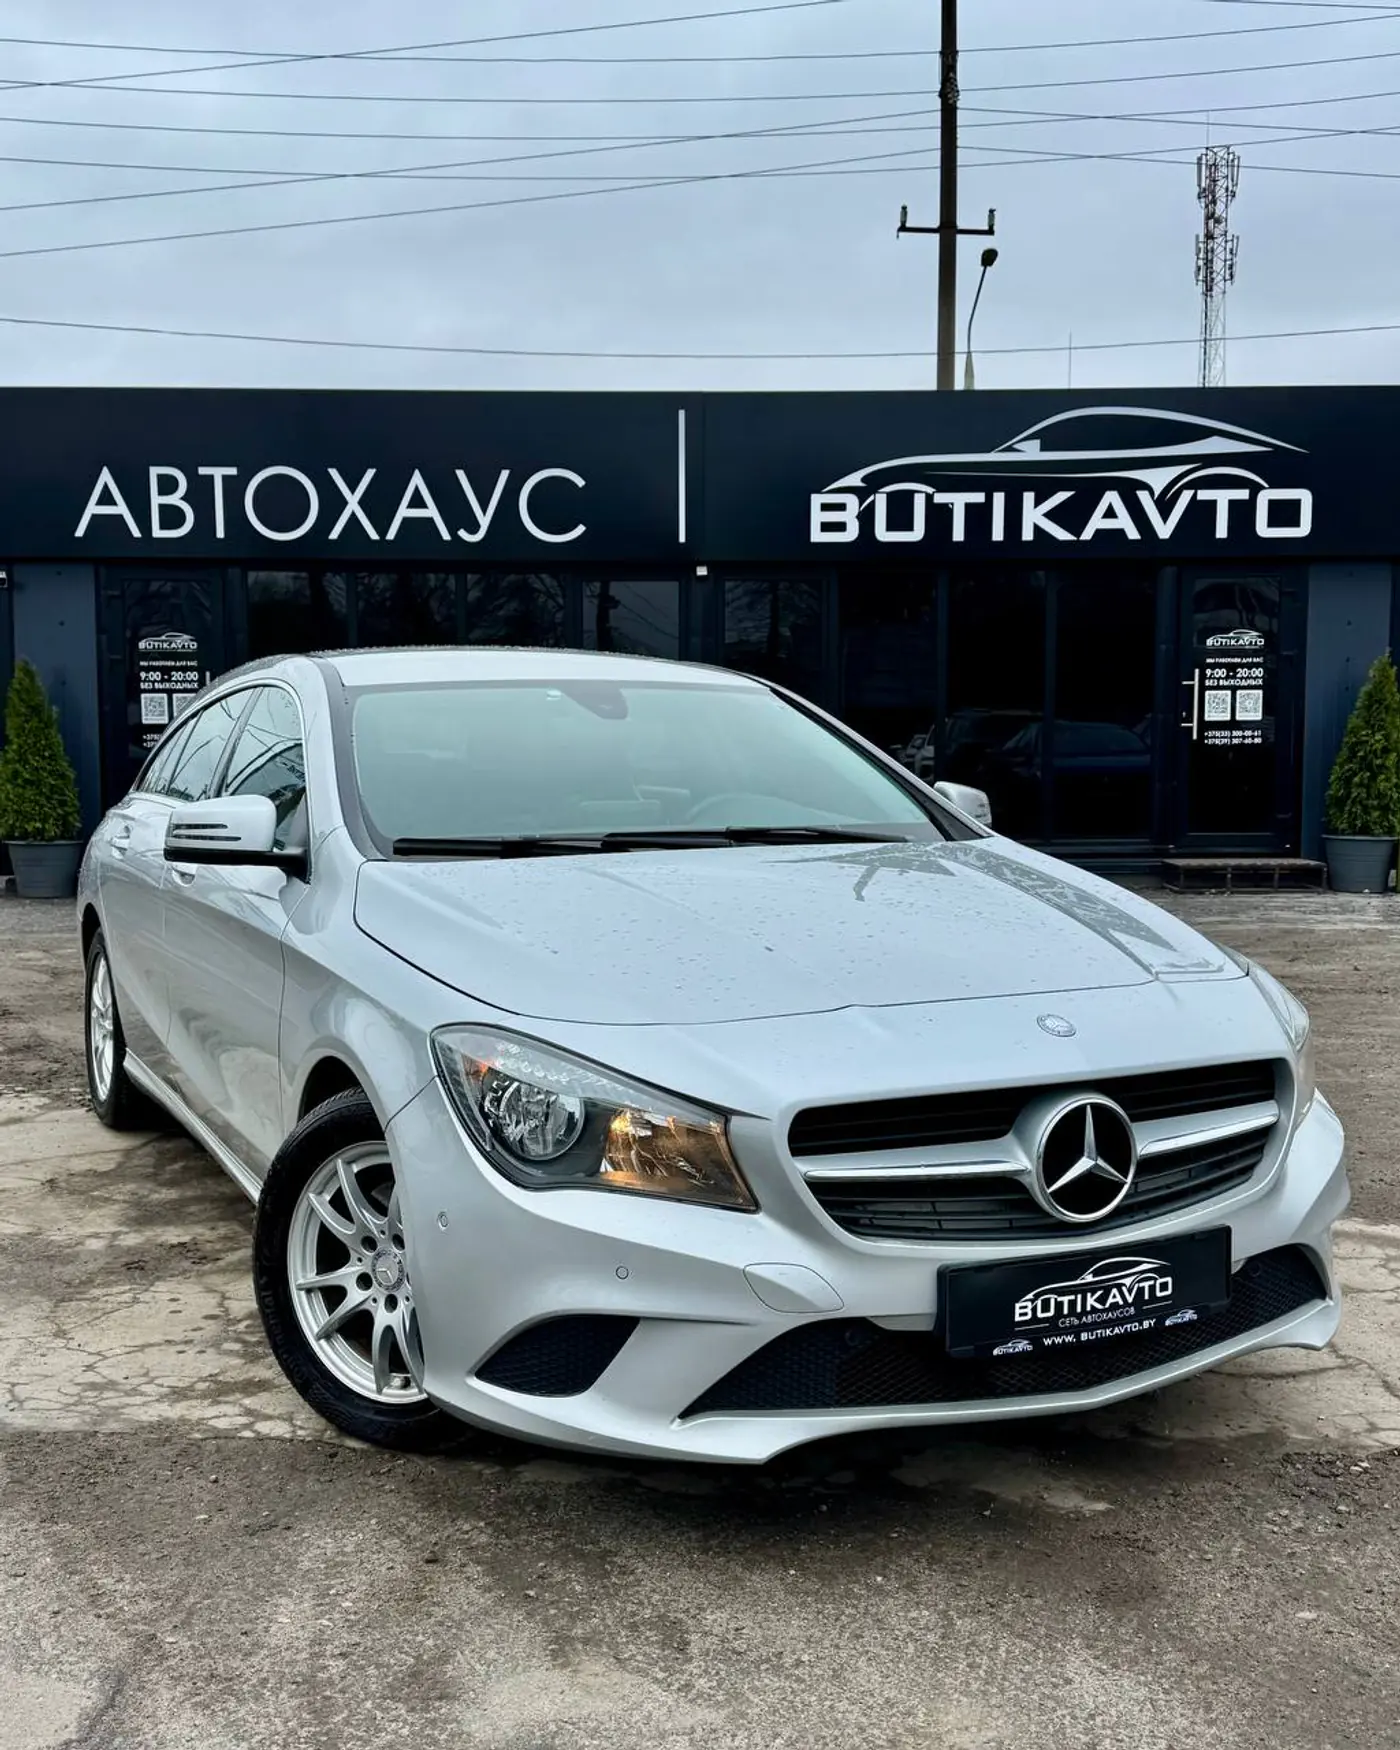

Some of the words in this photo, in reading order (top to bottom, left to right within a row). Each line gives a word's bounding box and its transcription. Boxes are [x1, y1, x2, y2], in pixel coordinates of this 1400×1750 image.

[74, 465, 587, 543] АВТОХАУС
[810, 488, 1313, 543] BUTIKAVTO
[138, 641, 198, 649] BUTIKAVTO
[139, 671, 162, 681] 9:00
[170, 671, 199, 681] 20:00
[1205, 668, 1227, 678] 9:00
[1236, 667, 1264, 678] 20:00
[1219, 678, 1263, 686] ВЫХОДНЫХ
[1014, 1276, 1173, 1322] BUTIKAVTO
[1058, 1317, 1080, 1328] СЕТЬ
[1080, 1306, 1136, 1324] АВТОХАУСОВ
[1043, 1334, 1076, 1346] WWW.
